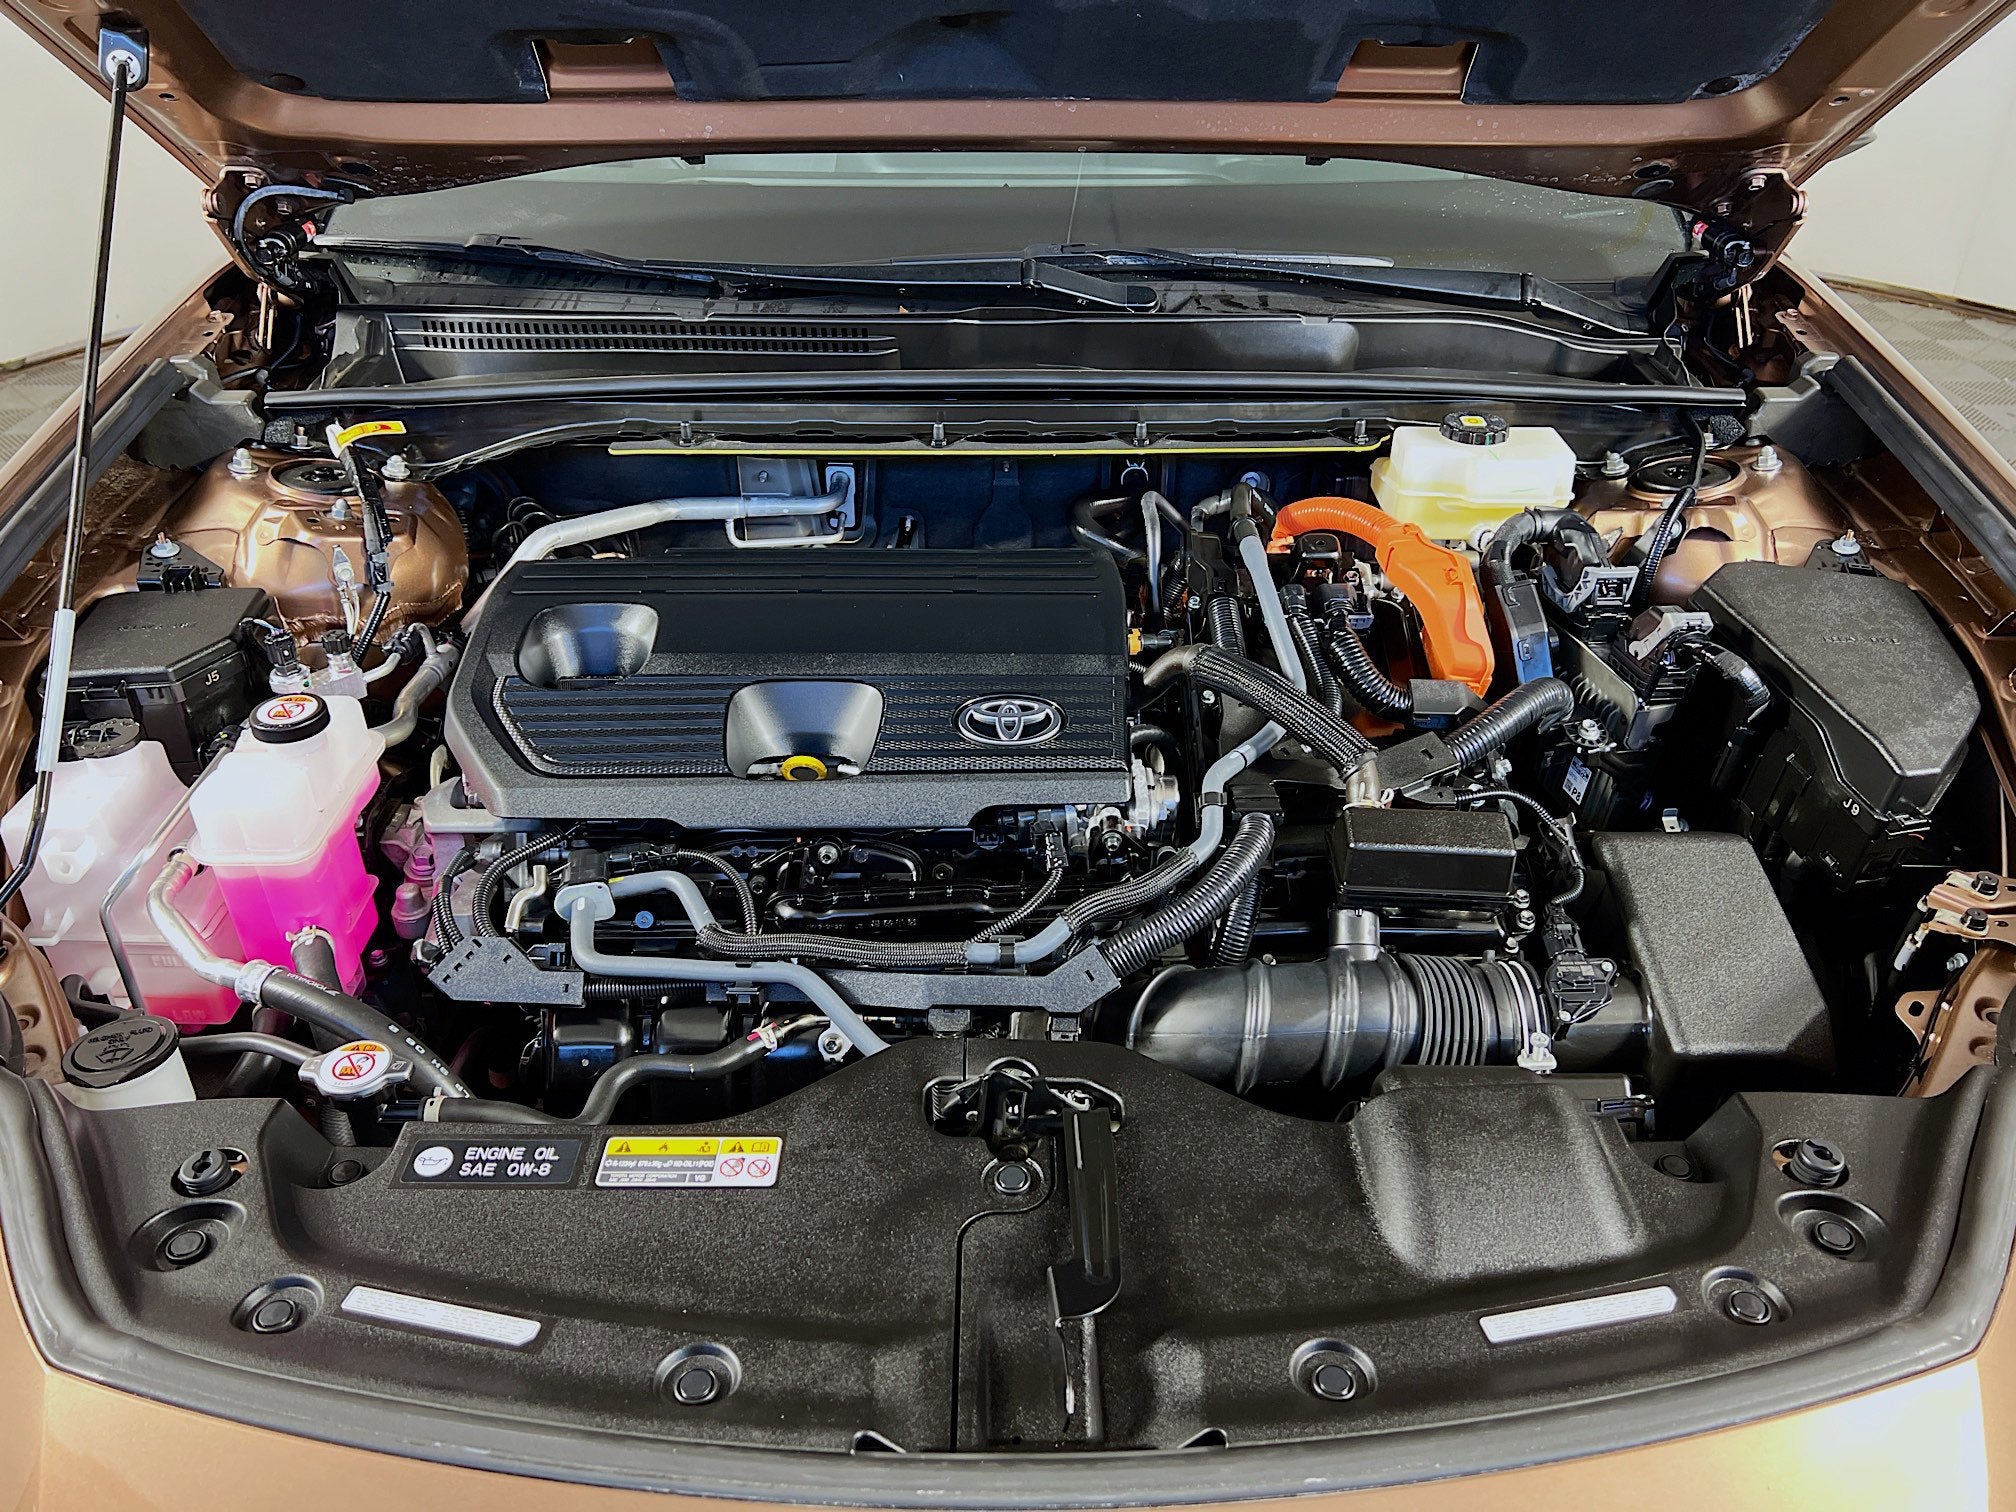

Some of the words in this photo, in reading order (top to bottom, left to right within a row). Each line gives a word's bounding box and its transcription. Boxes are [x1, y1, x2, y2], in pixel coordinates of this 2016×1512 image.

[205, 670, 220, 686] J5
[1842, 798, 1860, 816] J9
[464, 1146, 527, 1161] ENGINE
[533, 1146, 560, 1161] OIL
[459, 1162, 498, 1177] SAE
